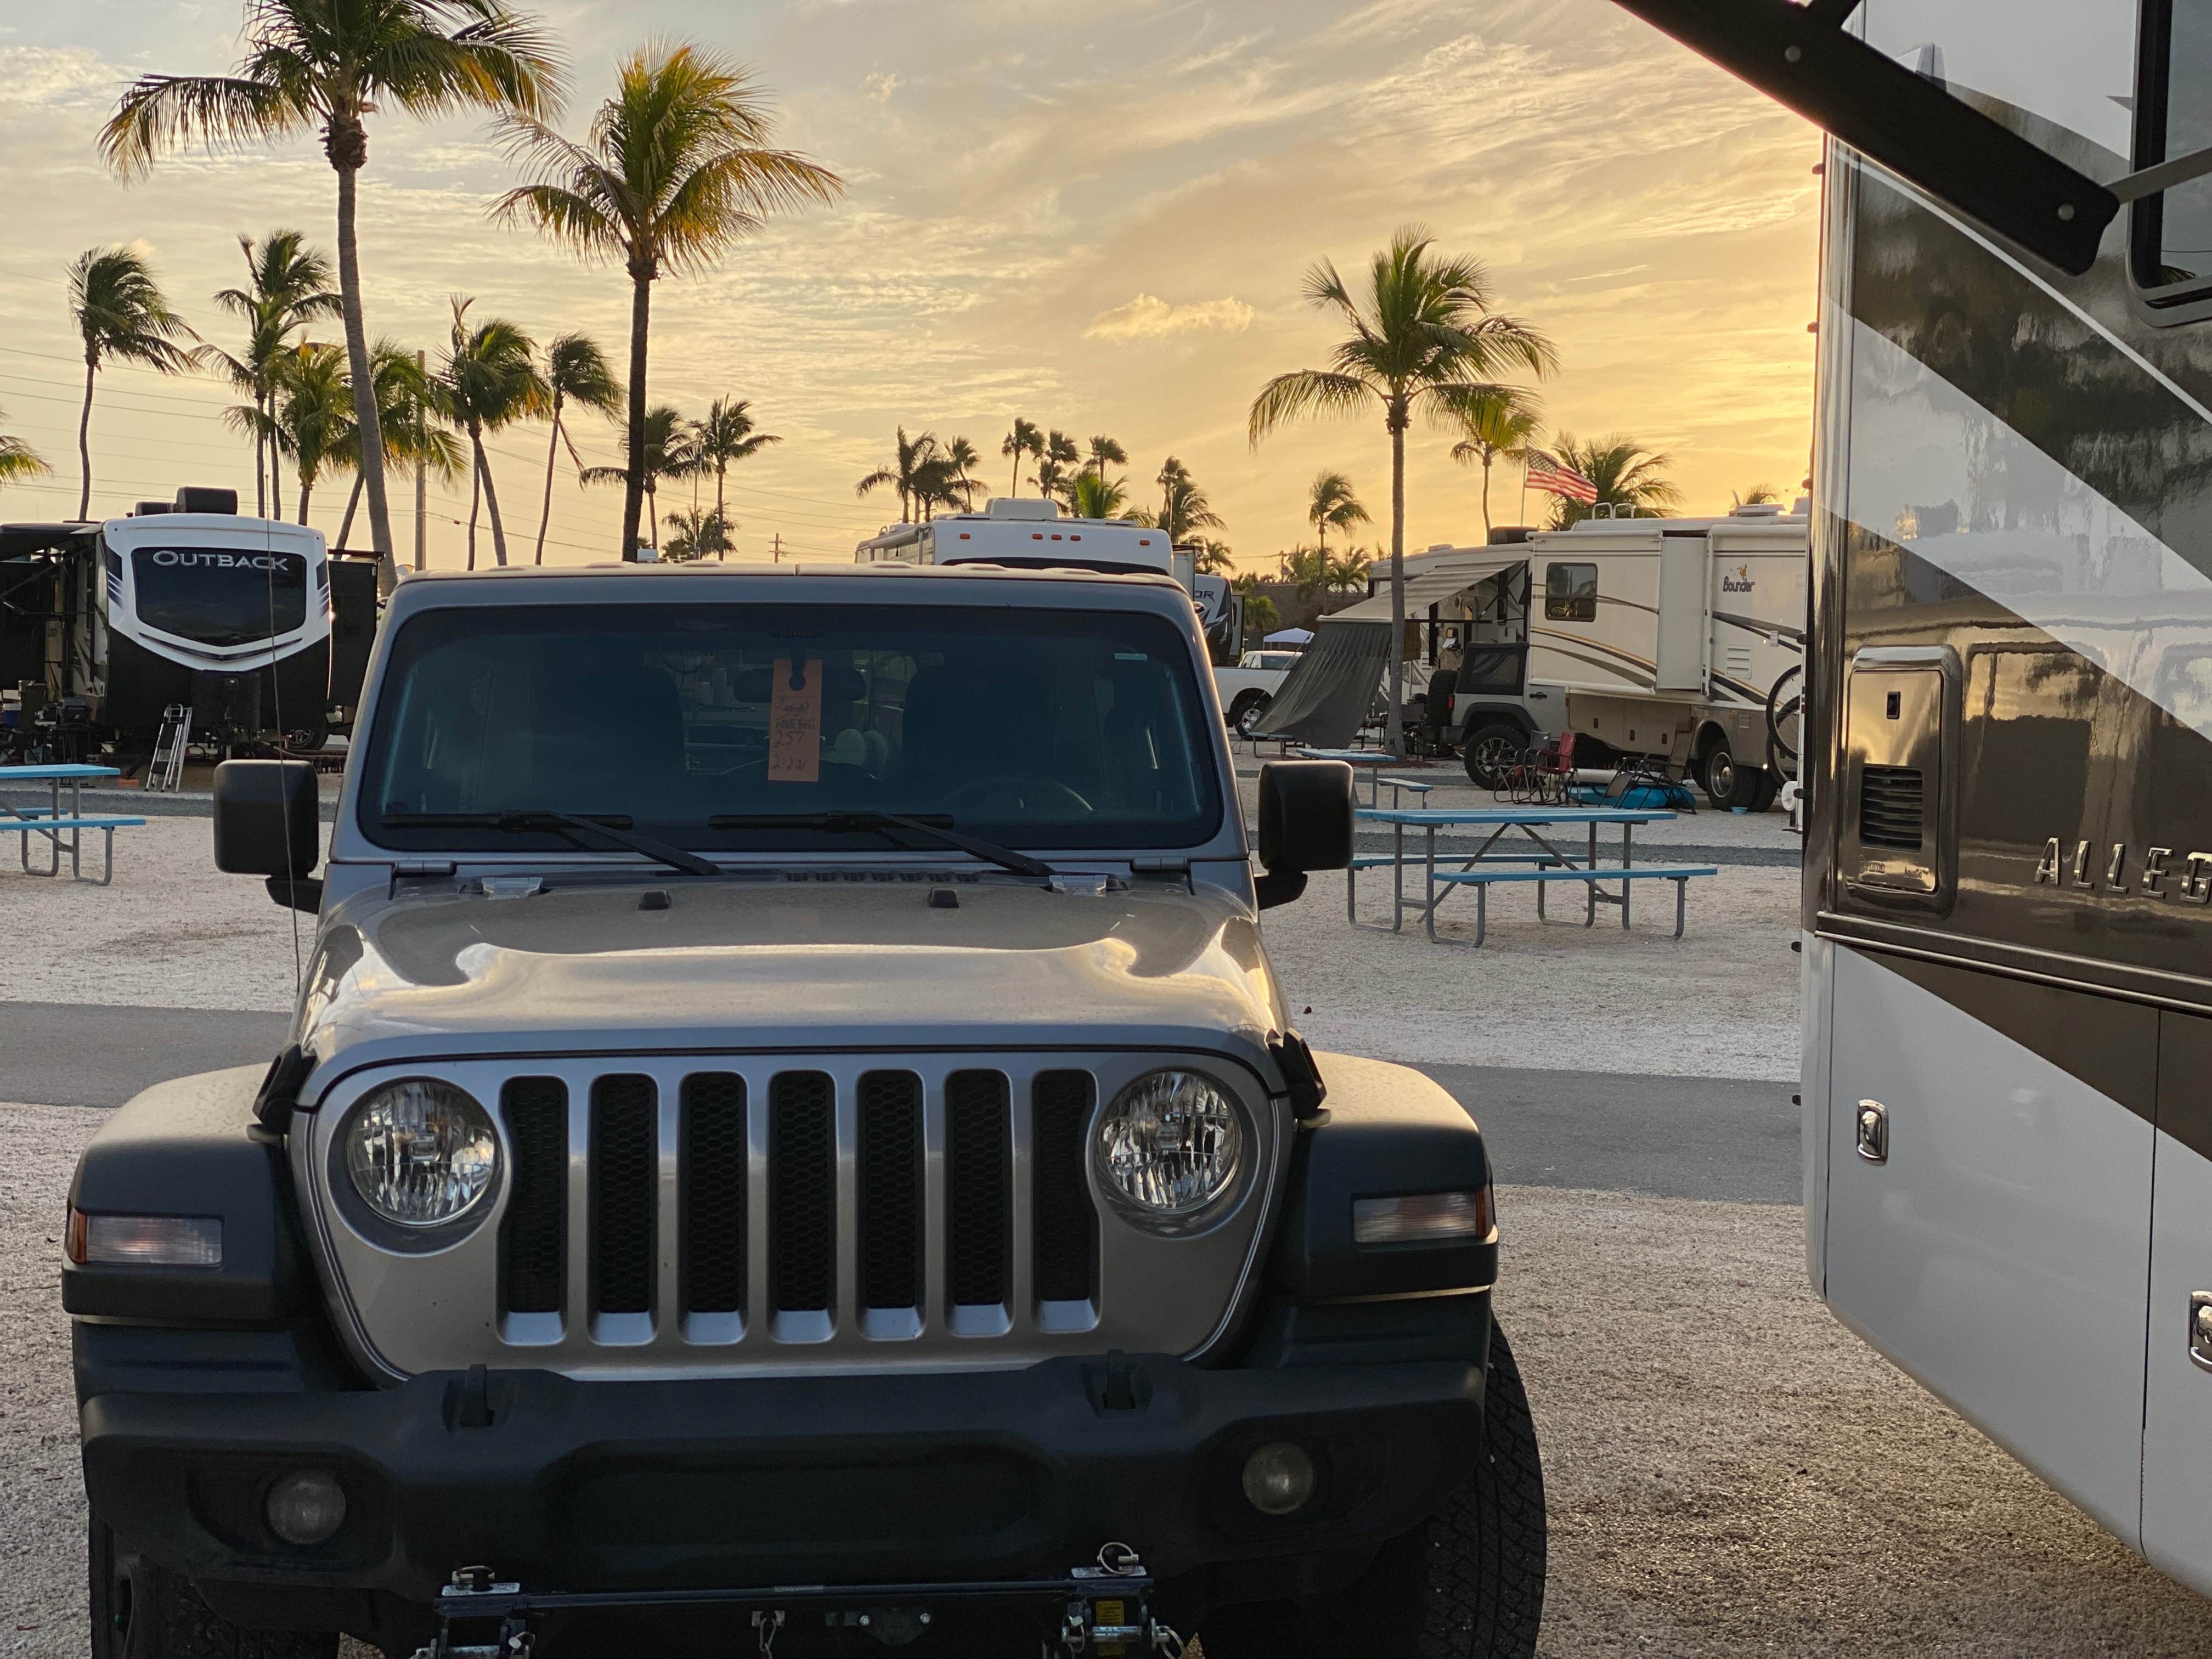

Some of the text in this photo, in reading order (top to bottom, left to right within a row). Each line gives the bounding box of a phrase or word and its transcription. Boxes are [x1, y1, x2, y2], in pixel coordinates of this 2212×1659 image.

[153, 550, 288, 571] OUTBACK
[1723, 575, 1755, 592] Bounder
[772, 730, 805, 747] 257
